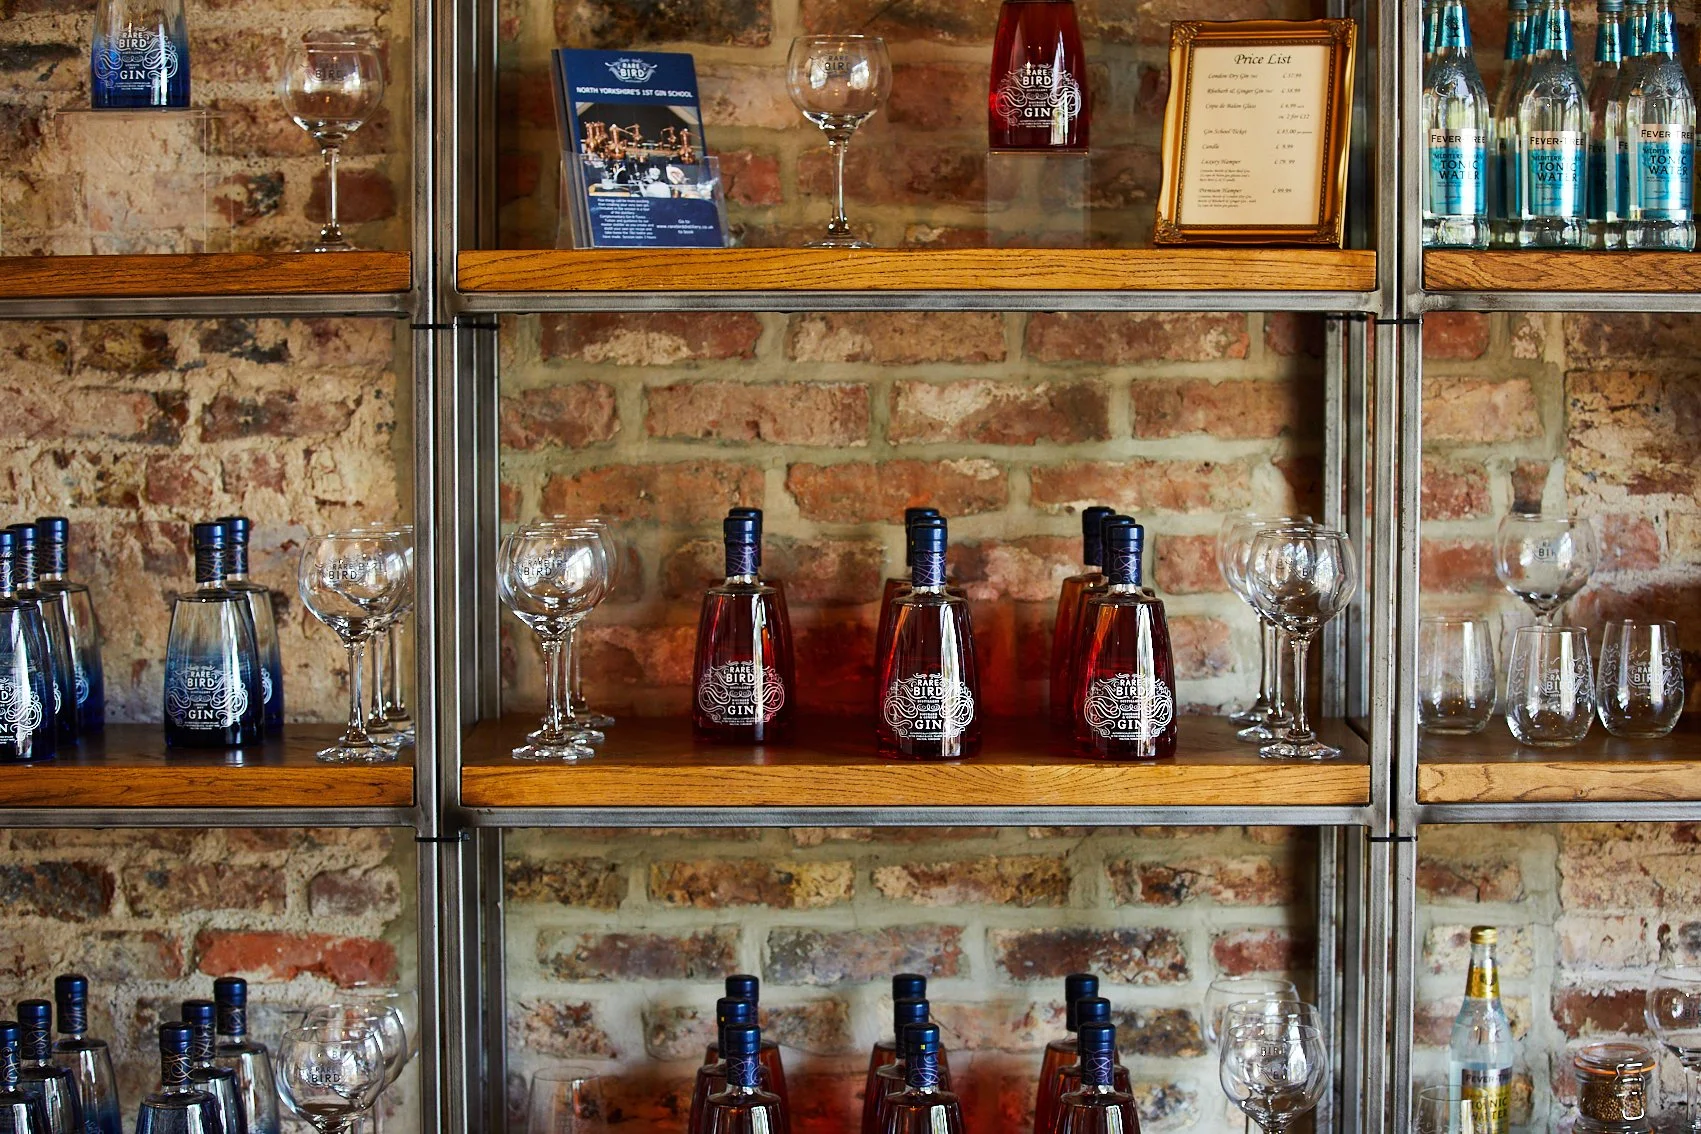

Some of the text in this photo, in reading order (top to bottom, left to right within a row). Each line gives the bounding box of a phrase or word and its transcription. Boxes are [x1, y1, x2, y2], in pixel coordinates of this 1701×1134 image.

[119, 39, 147, 48] BIRD
[1234, 53, 1292, 65] Price List
[120, 70, 146, 80] GIN
[620, 69, 645, 78] BIRD
[1022, 76, 1051, 86] BIRD
[576, 86, 599, 94] NORTH
[667, 90, 693, 98] SCHOOL
[1024, 108, 1051, 117] GIN
[329, 571, 357, 580] BIRD
[524, 566, 552, 576] BIRD
[187, 678, 214, 687] BIRD
[726, 674, 754, 682] BIRD
[914, 687, 943, 696] BIRD
[1116, 687, 1145, 696] BIRD
[188, 710, 214, 719] GIN
[728, 706, 754, 715] GIN
[915, 720, 942, 729] GIN
[311, 1074, 341, 1083] BIRD
